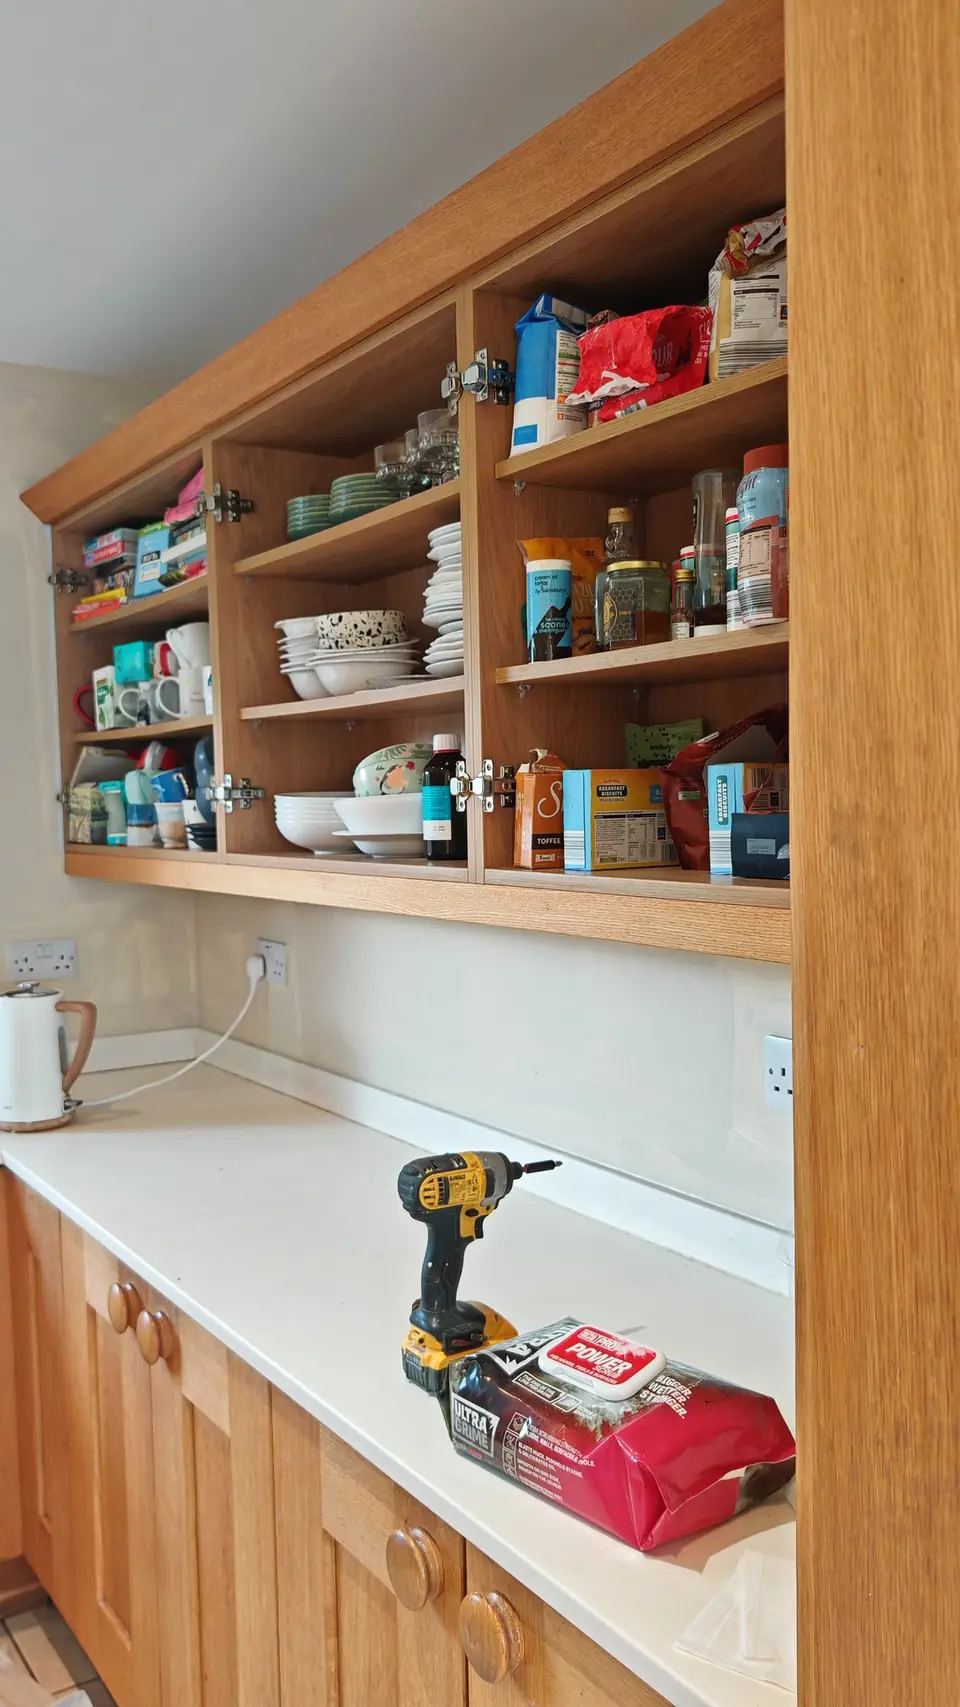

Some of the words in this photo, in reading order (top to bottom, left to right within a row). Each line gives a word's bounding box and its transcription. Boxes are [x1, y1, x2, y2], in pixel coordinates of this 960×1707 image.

[537, 837, 561, 845] TOFFEE
[565, 1342, 633, 1374] POWER
[592, 1365, 621, 1379] SCRUB
[648, 1381, 687, 1406] WETTER.
[655, 1375, 692, 1399] BIGGER.
[454, 1399, 488, 1434] ULTRA
[454, 1415, 489, 1450] GRIME
